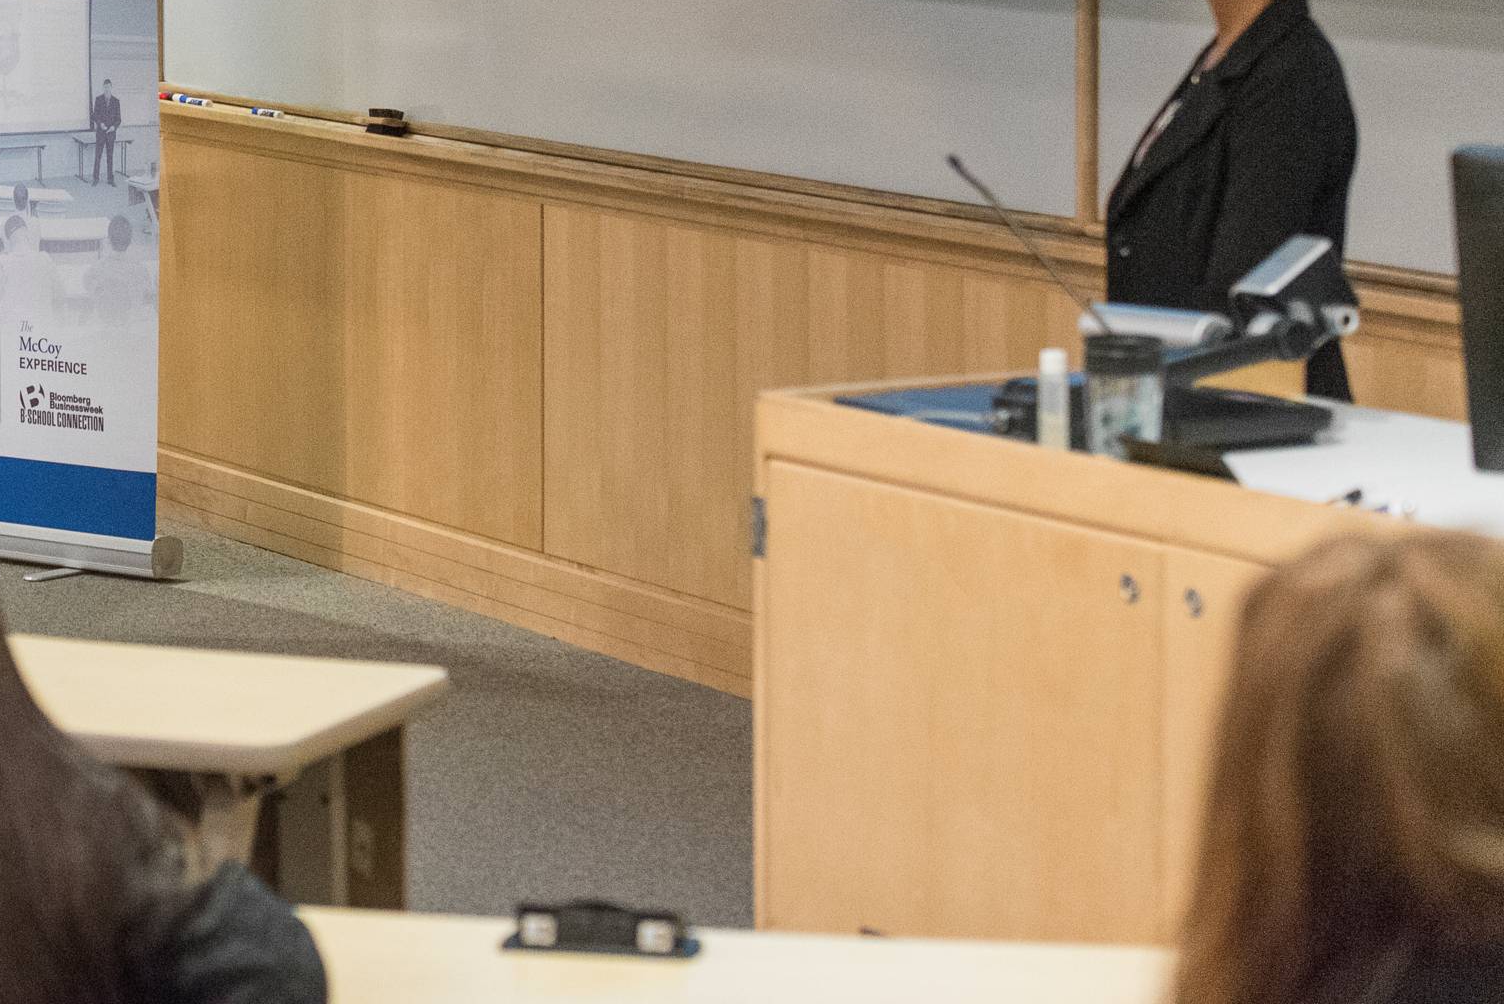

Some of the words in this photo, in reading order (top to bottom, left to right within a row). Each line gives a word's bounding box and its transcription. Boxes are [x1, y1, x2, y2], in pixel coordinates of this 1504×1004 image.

[20, 320, 33, 332] The
[19, 336, 62, 359] McCoy
[20, 357, 87, 375] EXPERIENCE
[50, 392, 90, 405] Bloomberg
[50, 401, 103, 414] Businessweek
[21, 408, 56, 426] B-SCHOOL
[57, 413, 104, 432] CONNECTION
